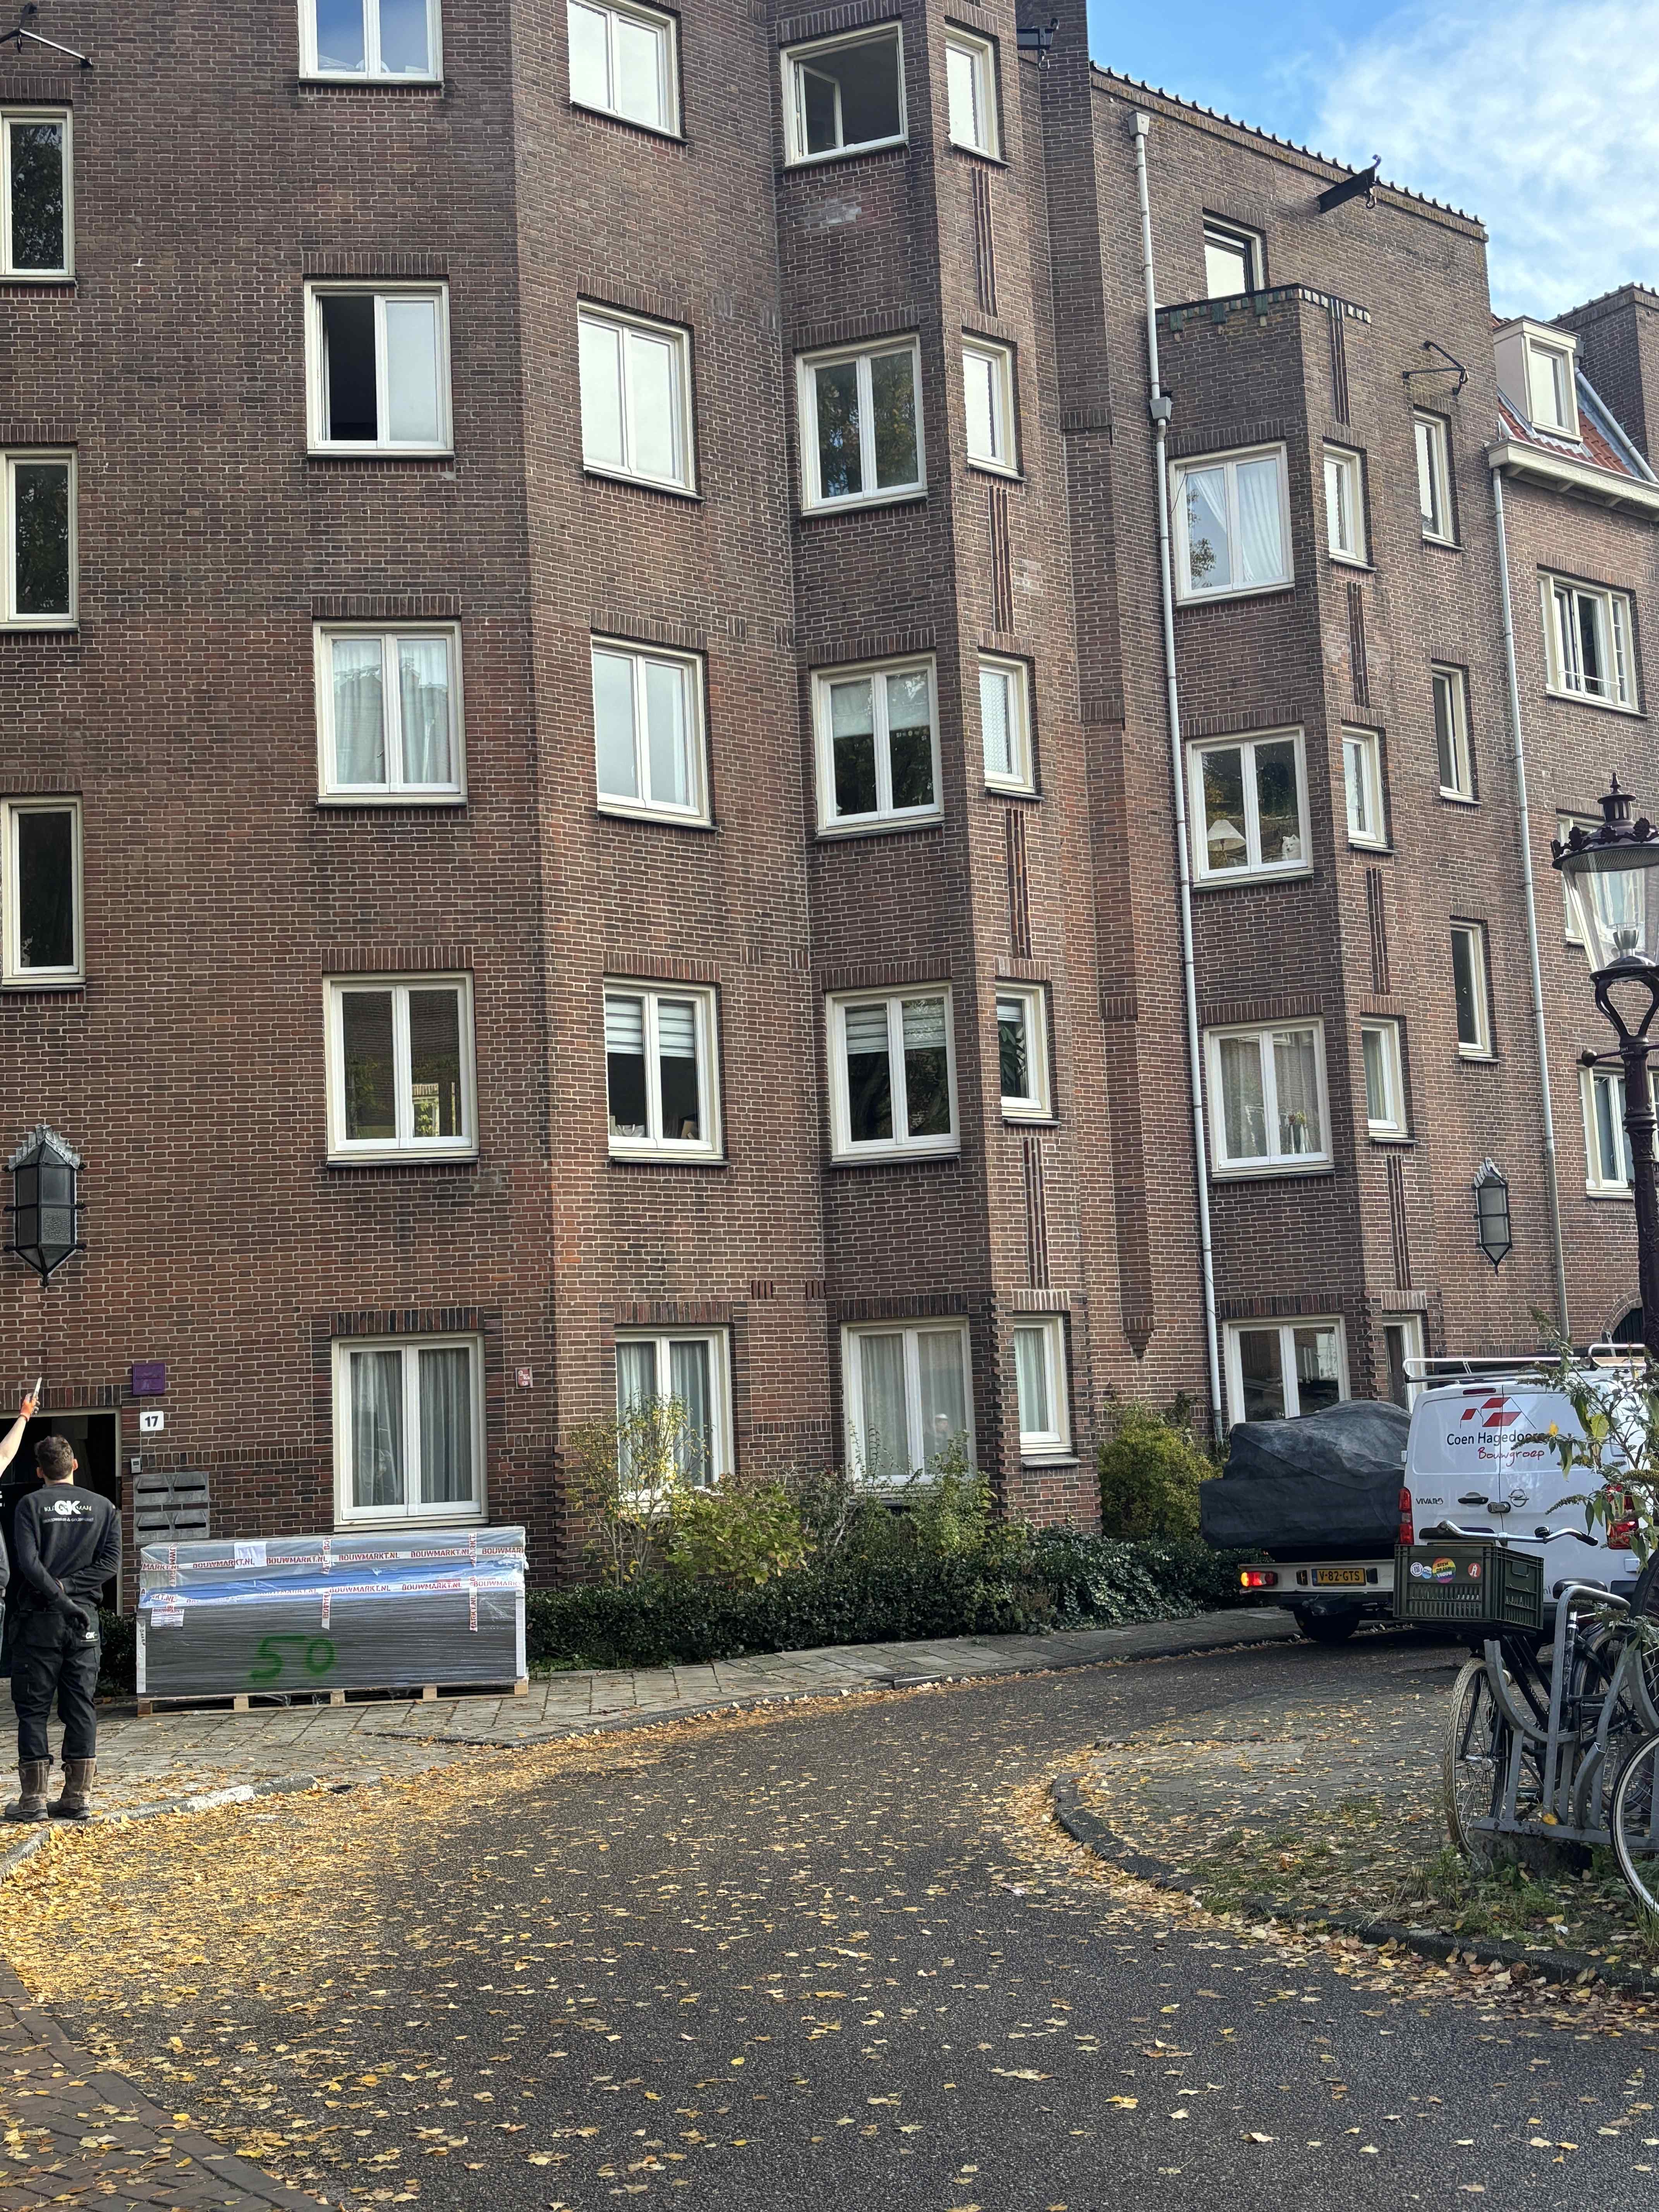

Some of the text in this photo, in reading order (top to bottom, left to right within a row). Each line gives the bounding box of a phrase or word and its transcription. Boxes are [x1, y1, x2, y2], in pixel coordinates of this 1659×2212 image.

[145, 1416, 158, 1427] 17
[1446, 1429, 1546, 1446] Coen Hagedoo
[1477, 1446, 1545, 1467] Bouwgroep
[142, 1561, 181, 1571] MARKT.NL
[192, 1558, 254, 1568] BOUWMARKT.NL
[266, 1556, 328, 1565] BOUWMARKT.NL
[338, 1552, 400, 1561] BOUWMARKT.NL
[1319, 1571, 1360, 1581] V-82-GTS
[402, 1582, 462, 1591] BOUWMARKT.NL
[250, 1635, 335, 1681] 50
